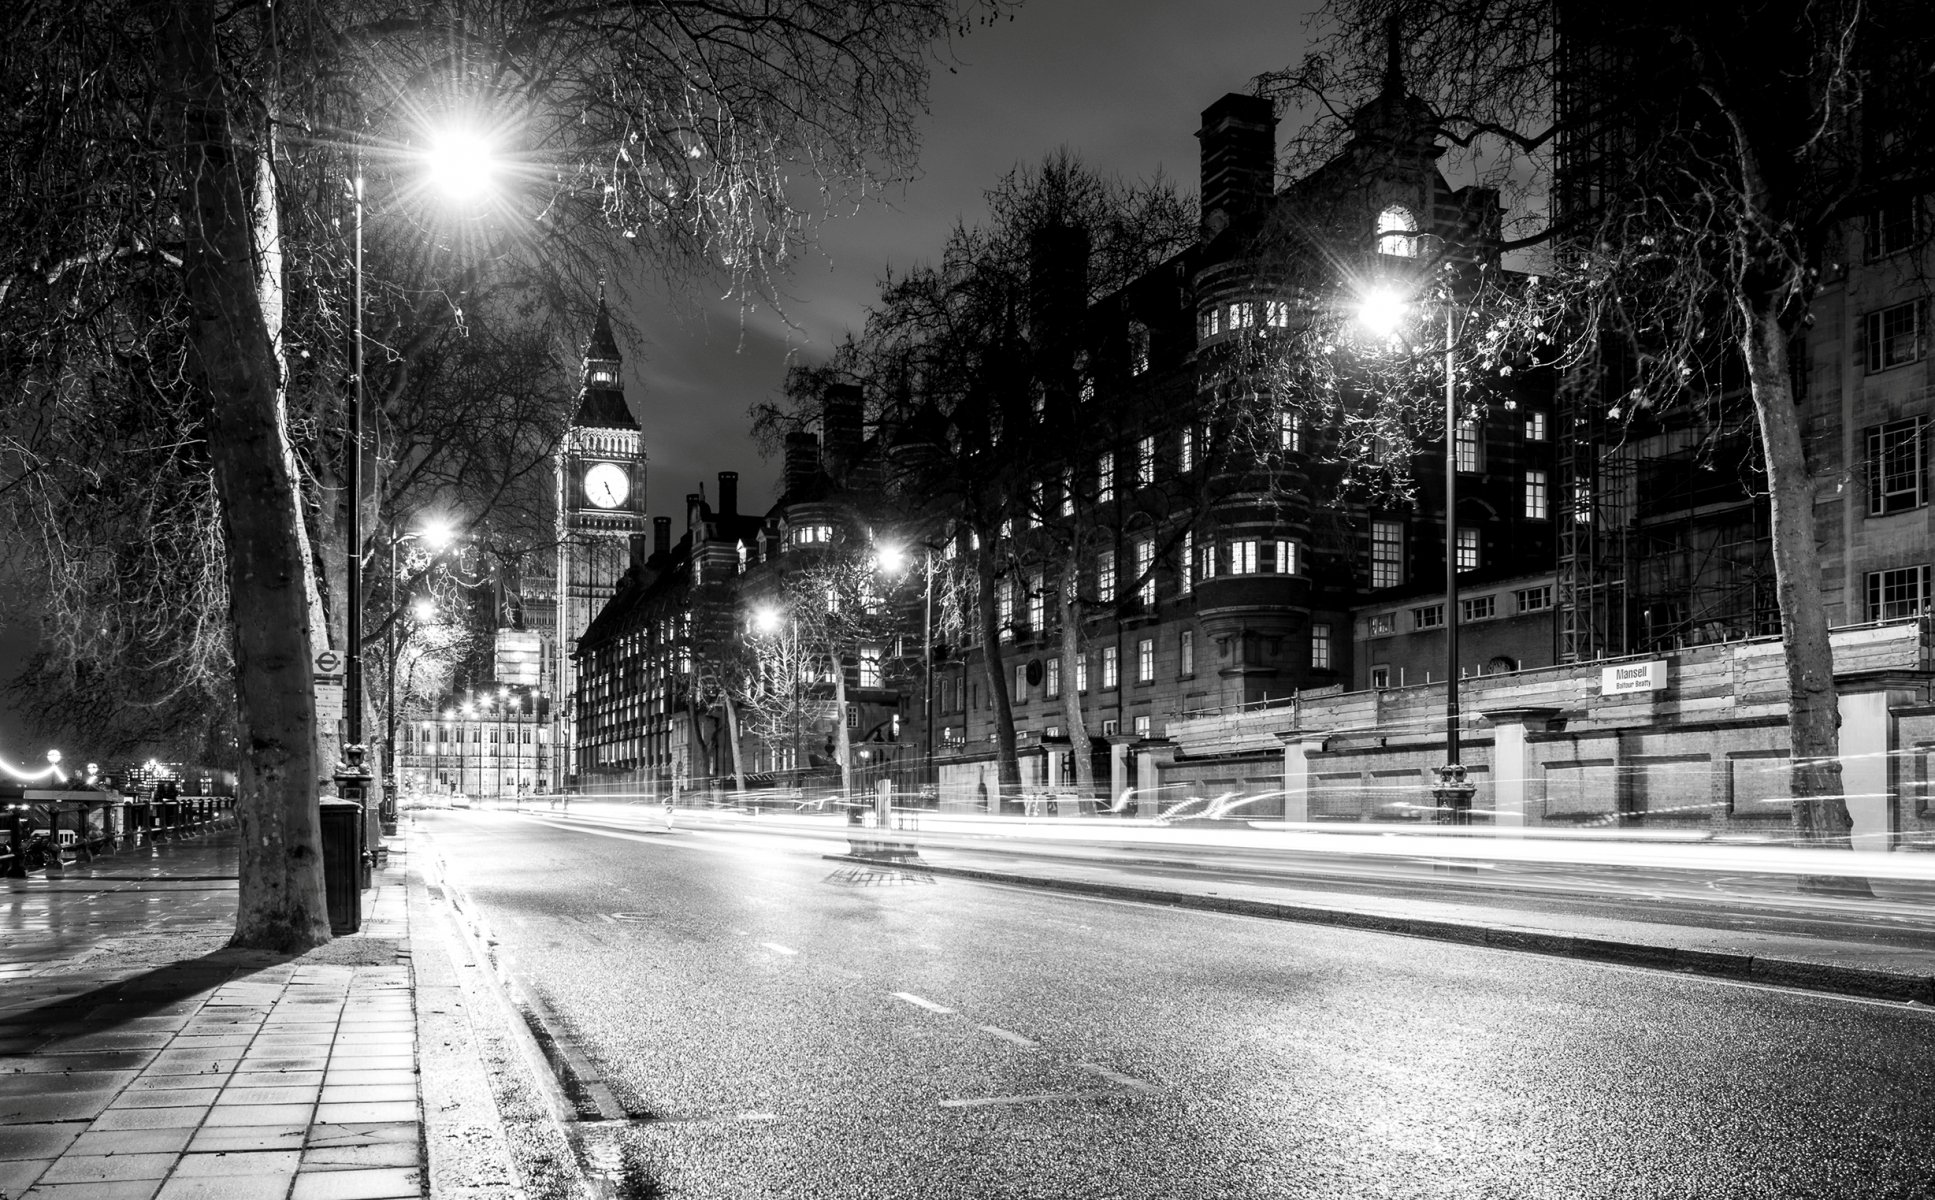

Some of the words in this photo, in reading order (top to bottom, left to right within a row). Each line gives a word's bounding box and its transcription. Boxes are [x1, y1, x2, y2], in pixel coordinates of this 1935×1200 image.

[1616, 665, 1647, 680] Mansell
[1616, 682, 1634, 690] Balfour
[1635, 680, 1651, 688] Beatty
